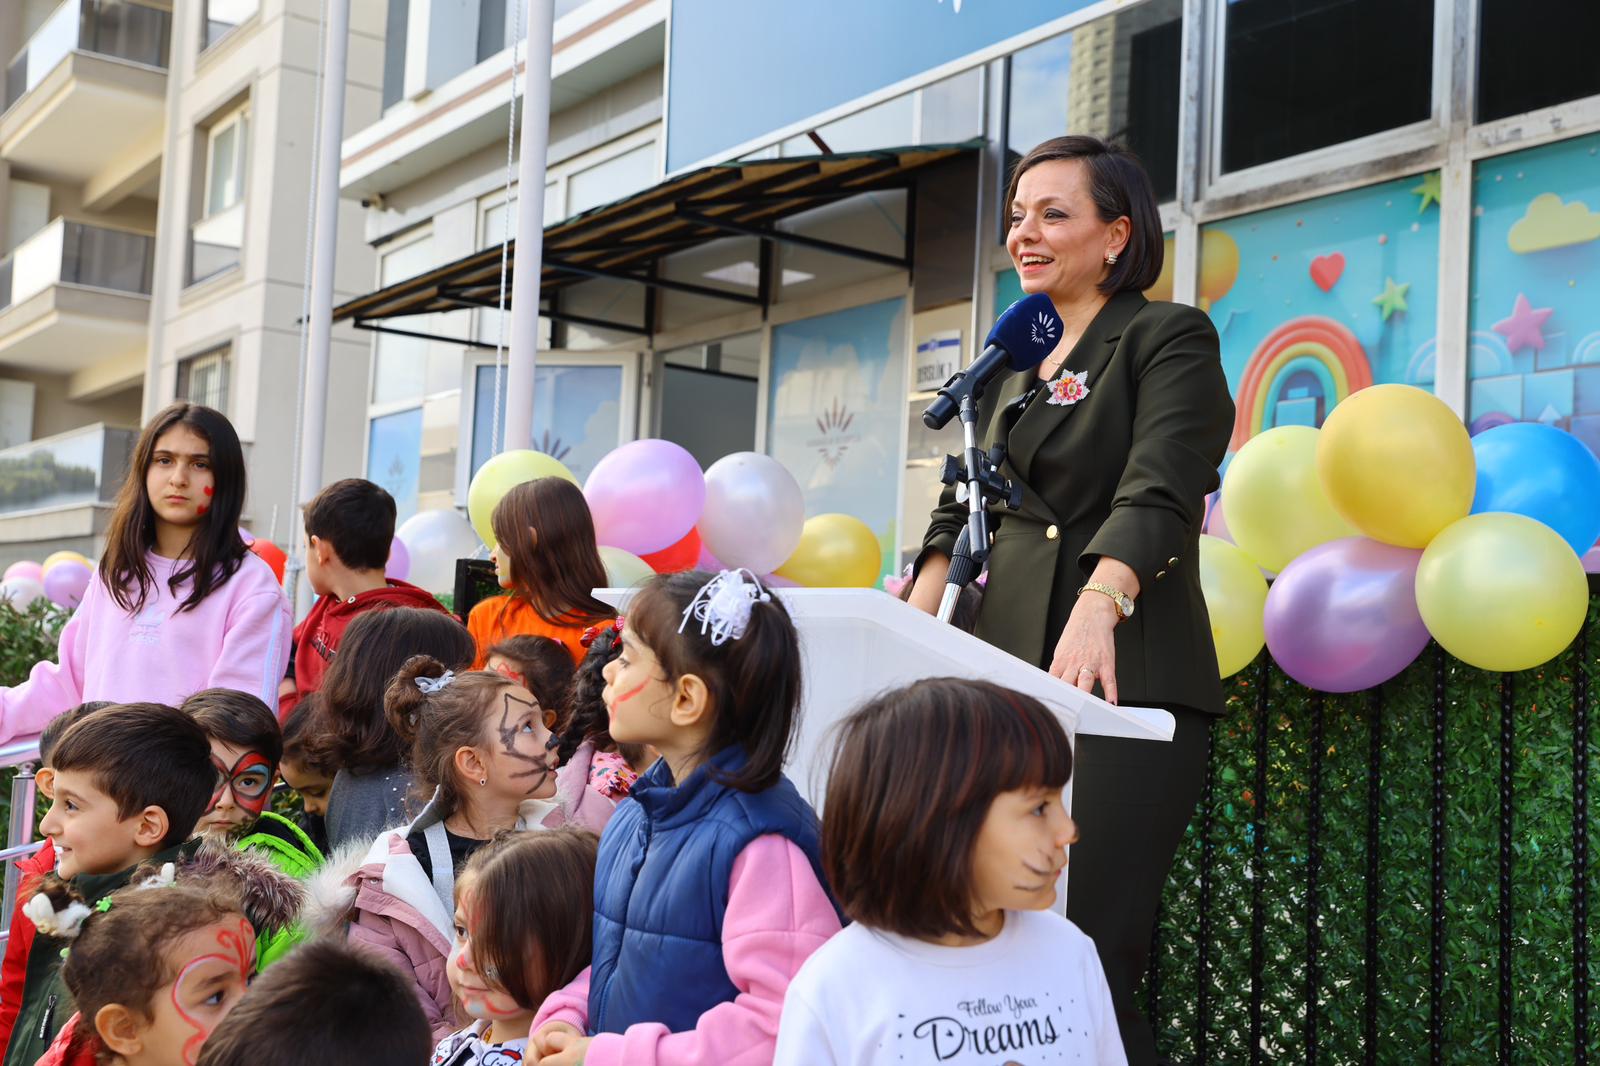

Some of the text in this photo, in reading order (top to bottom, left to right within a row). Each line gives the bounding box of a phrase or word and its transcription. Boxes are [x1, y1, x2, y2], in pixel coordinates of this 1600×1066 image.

[957, 994, 1038, 1018] Follow Your
[913, 1015, 1060, 1062] Dreams
